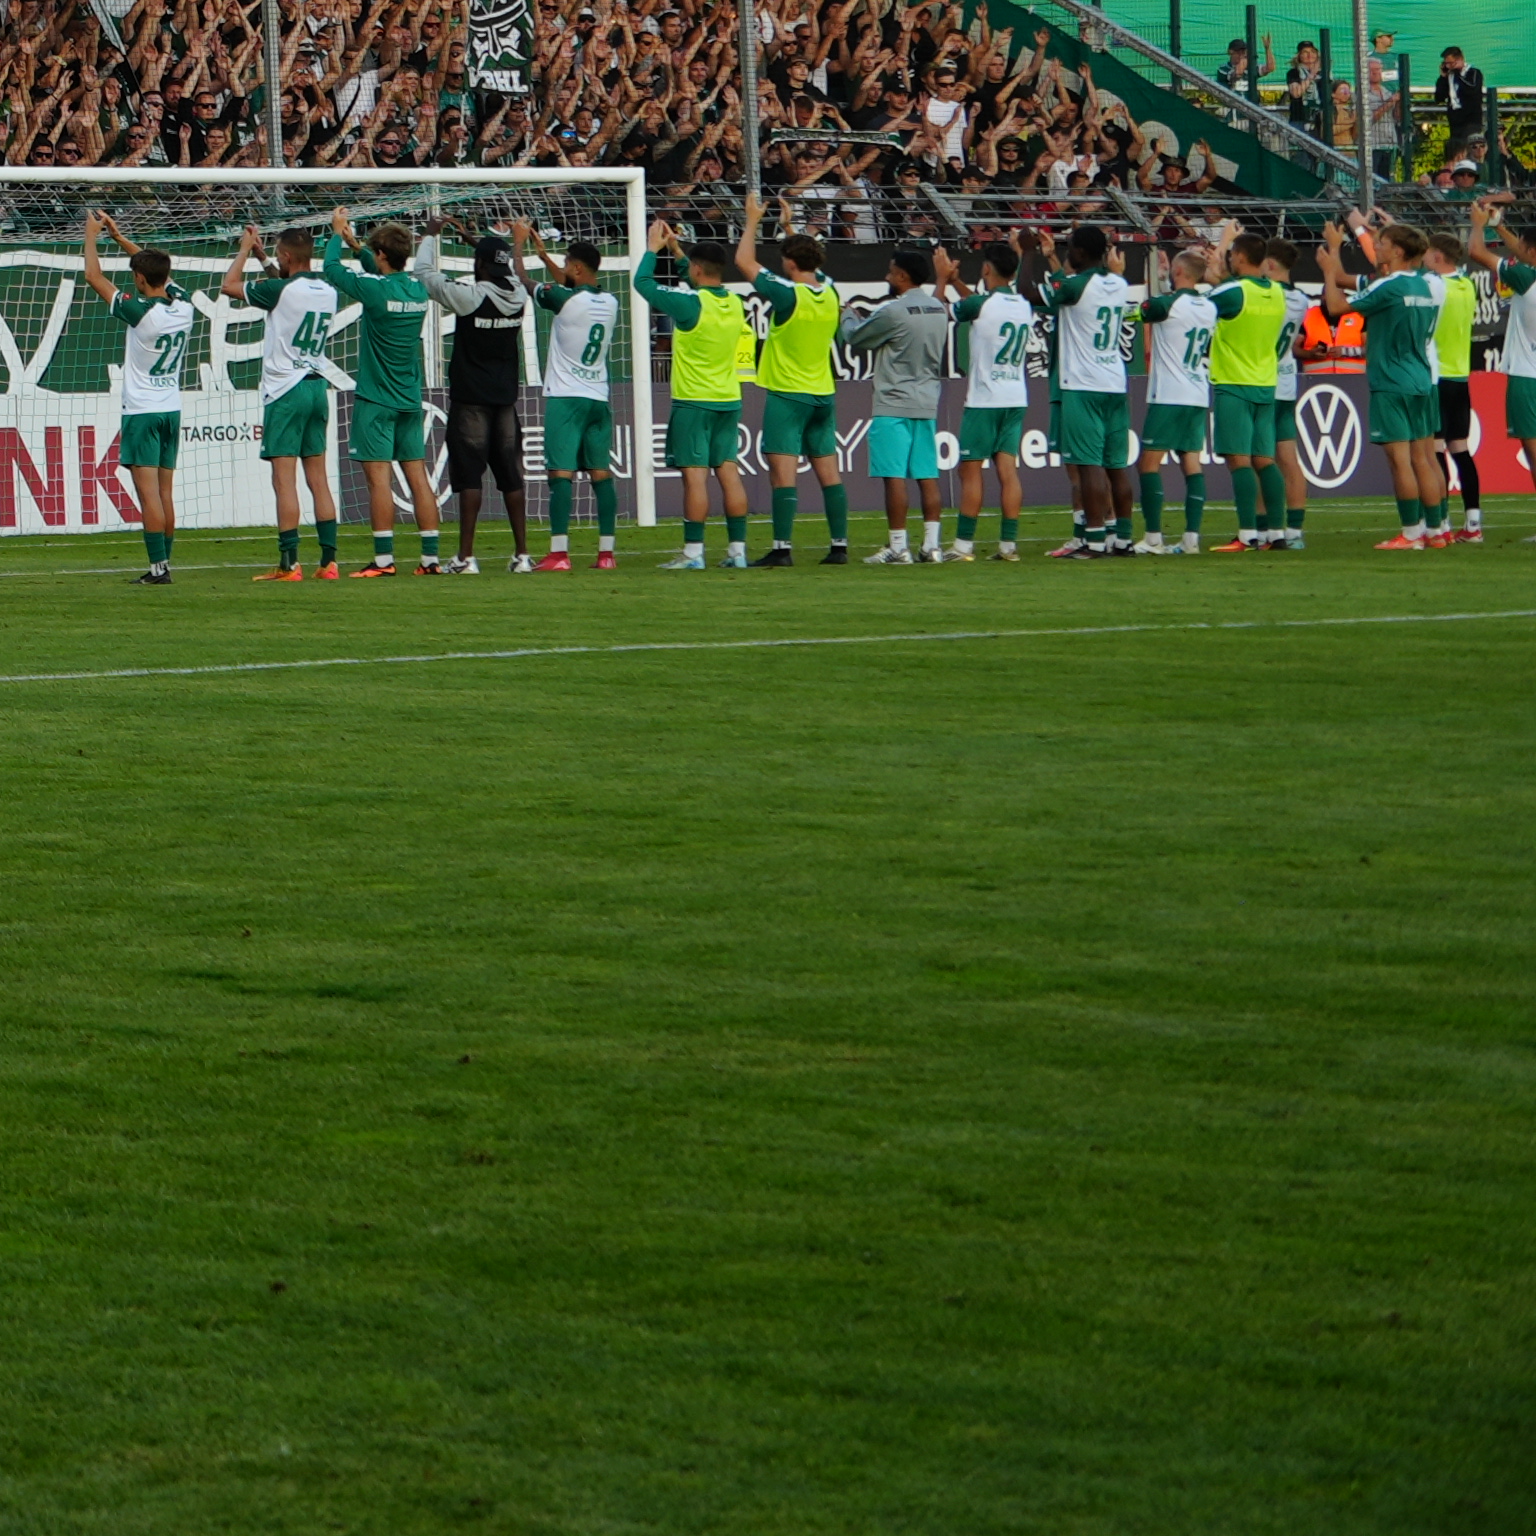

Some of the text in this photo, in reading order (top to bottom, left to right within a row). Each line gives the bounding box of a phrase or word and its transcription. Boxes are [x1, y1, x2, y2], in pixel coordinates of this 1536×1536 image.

[149, 330, 185, 376] 22
[291, 311, 333, 357] 45
[581, 323, 605, 367] 8
[994, 321, 1029, 367] 20
[1183, 326, 1209, 371] 13
